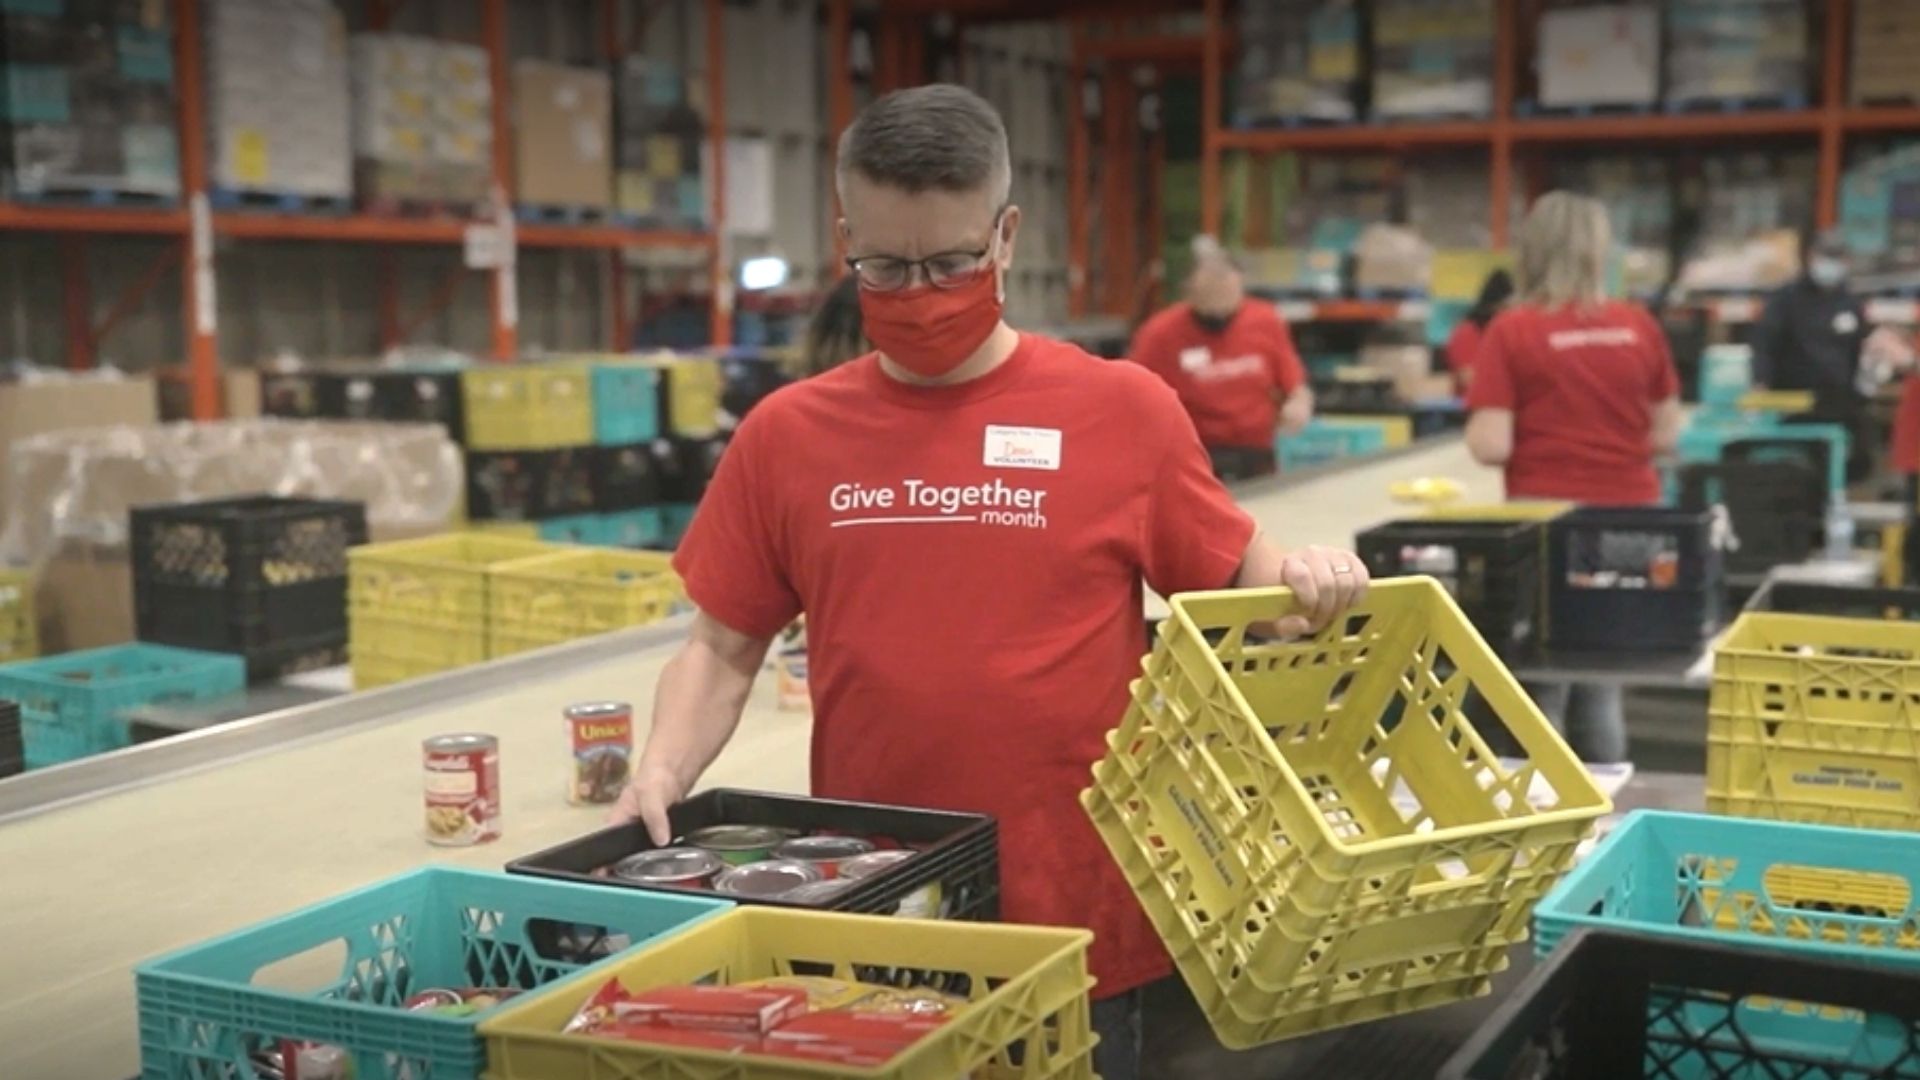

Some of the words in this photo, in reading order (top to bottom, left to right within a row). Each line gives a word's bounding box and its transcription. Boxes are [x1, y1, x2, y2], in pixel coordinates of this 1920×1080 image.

[993, 456, 1050, 466] VOLUNTEER
[829, 483, 895, 511] Give
[902, 477, 1047, 514] Together
[981, 508, 1047, 529] month
[579, 722, 628, 740] Unico
